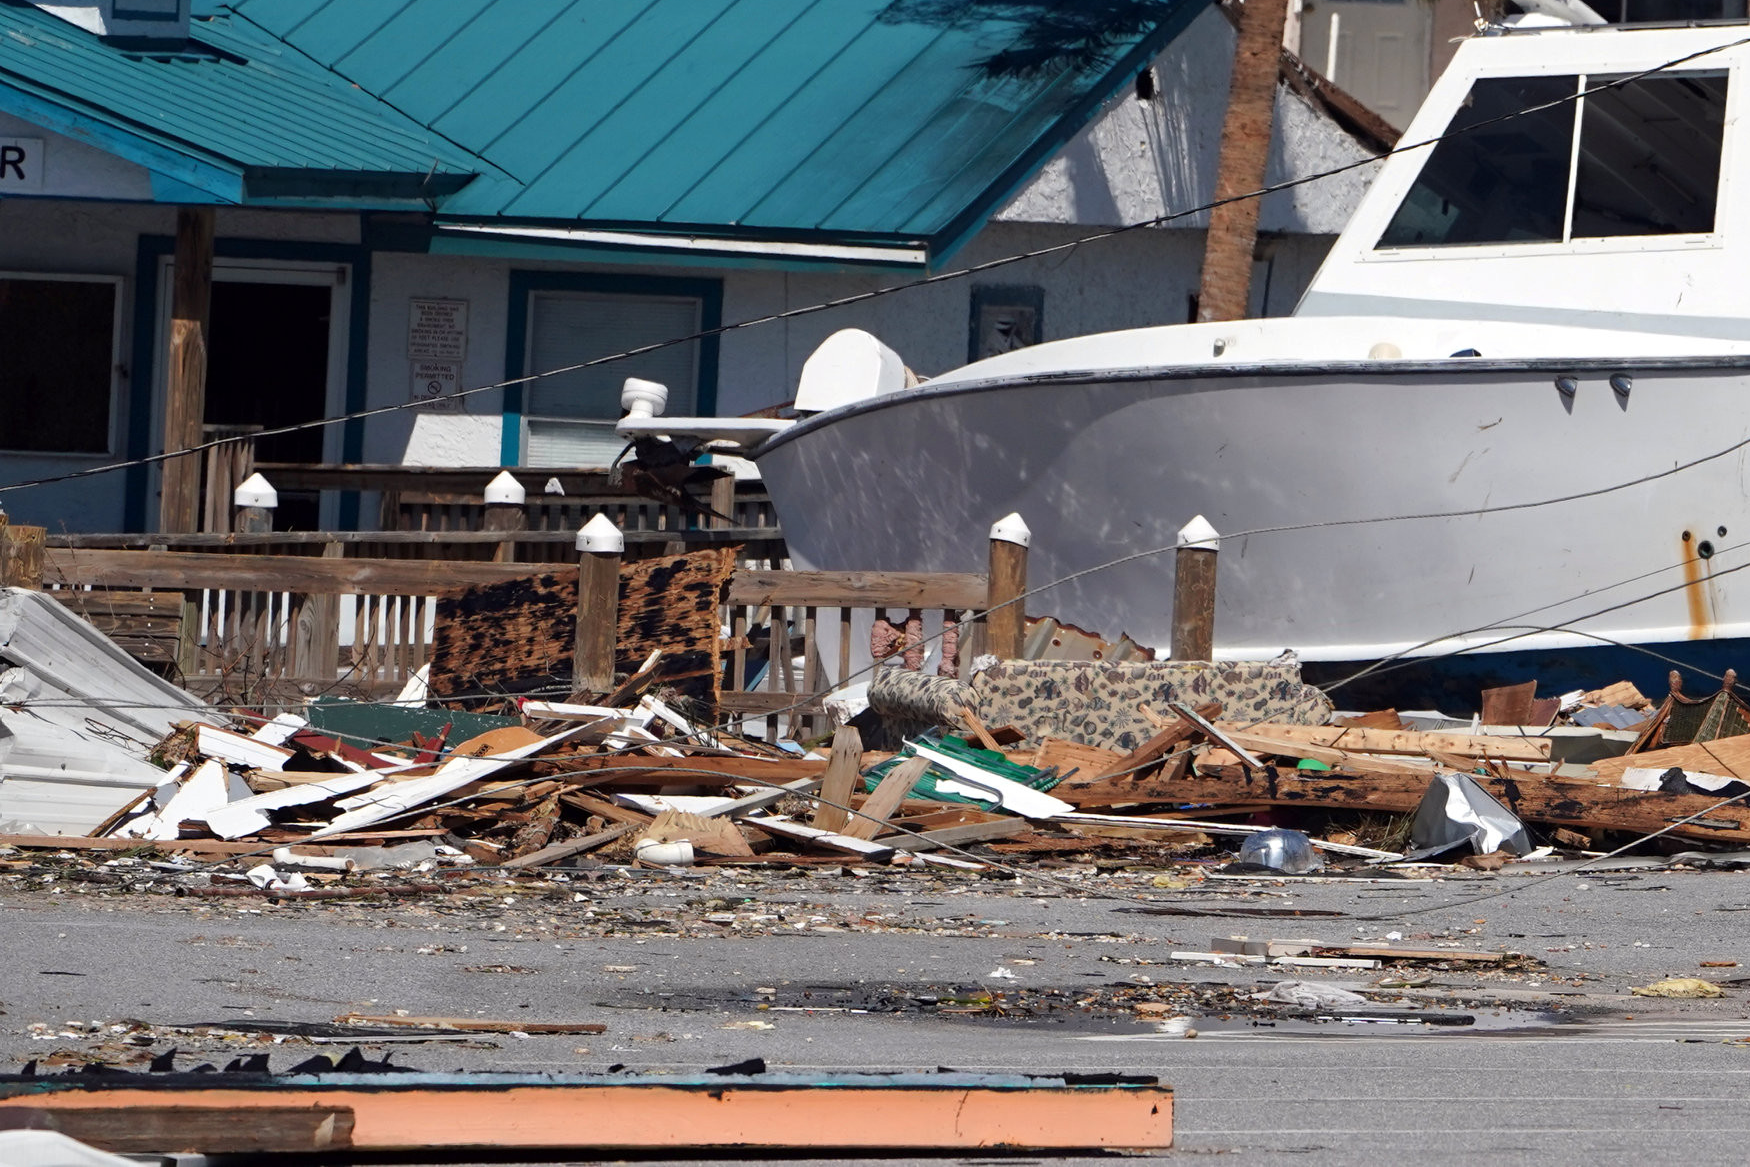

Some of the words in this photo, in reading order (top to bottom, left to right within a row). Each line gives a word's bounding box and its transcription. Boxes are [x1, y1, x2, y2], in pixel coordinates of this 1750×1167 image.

[0, 145, 31, 191] R
[419, 364, 452, 373] SMOKING
[415, 372, 455, 380] PERMITTED
